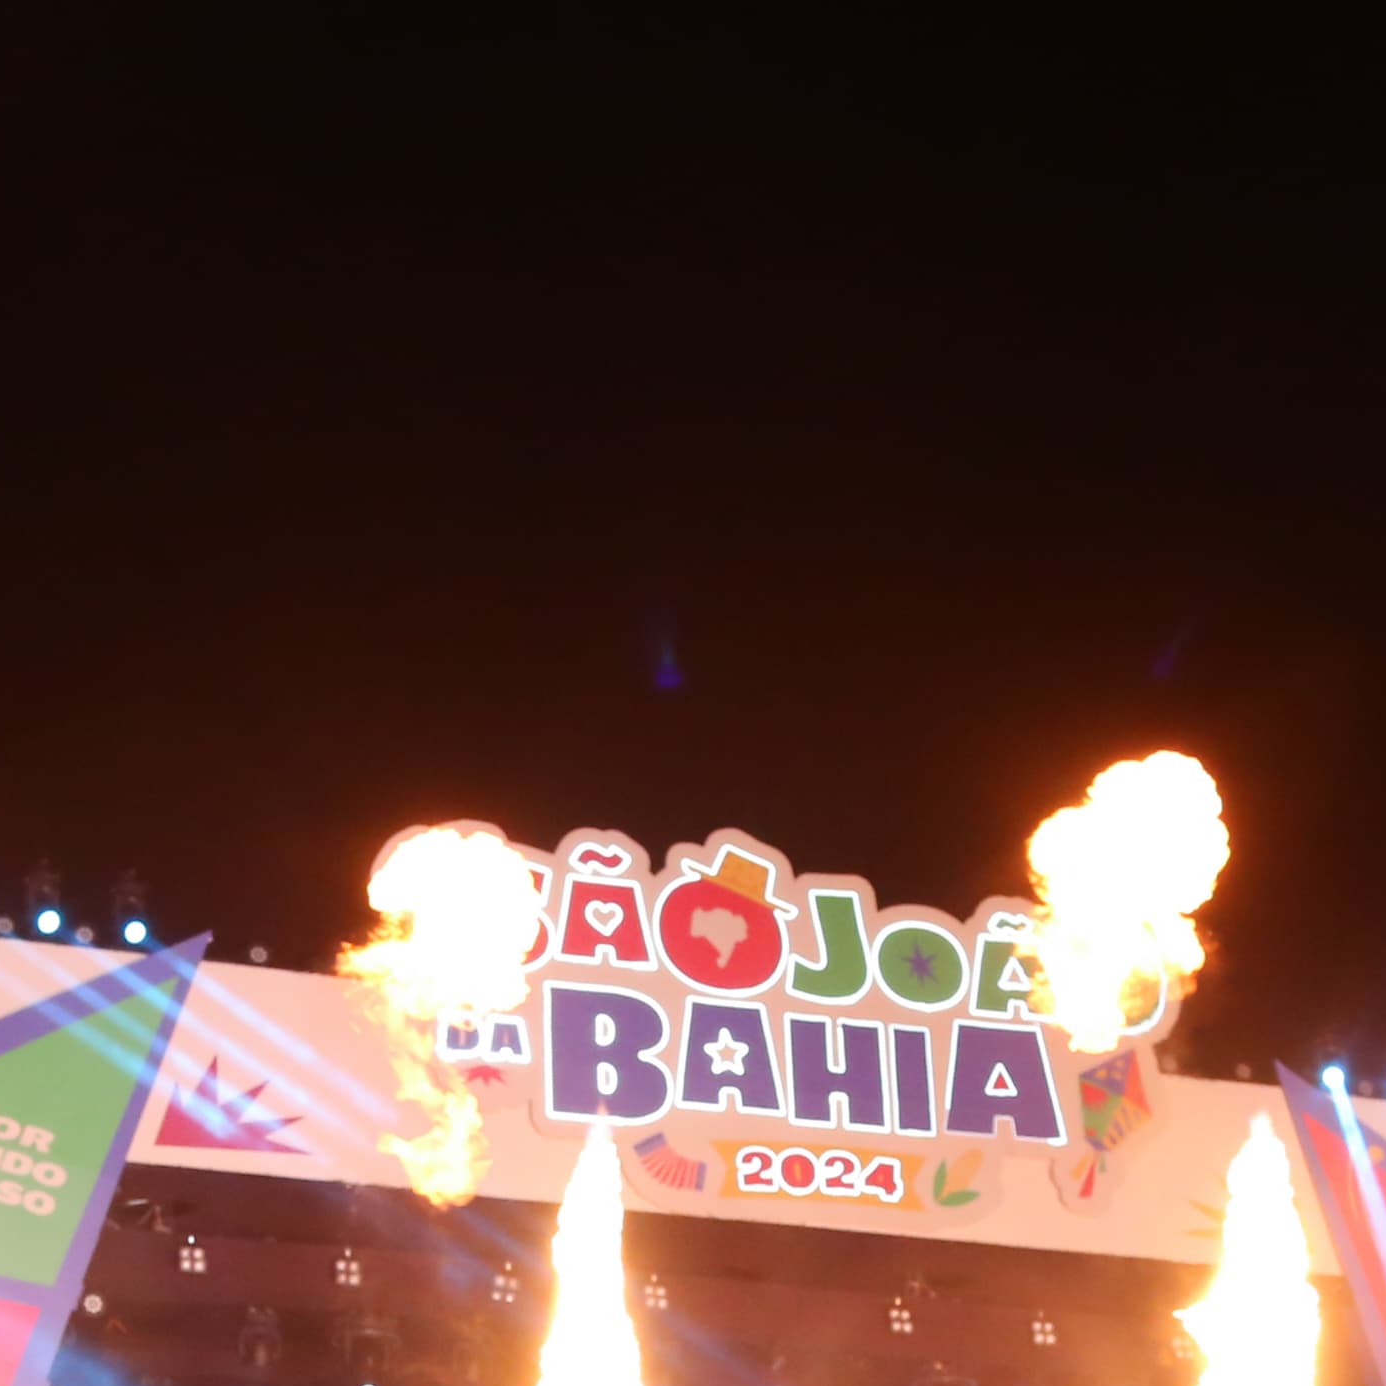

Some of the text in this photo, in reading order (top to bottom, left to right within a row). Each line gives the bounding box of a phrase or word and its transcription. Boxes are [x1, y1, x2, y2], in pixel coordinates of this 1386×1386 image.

[518, 840, 785, 998] ÃO
[437, 979, 1067, 1146] DA BAHIA
[736, 1145, 904, 1202] 2024
